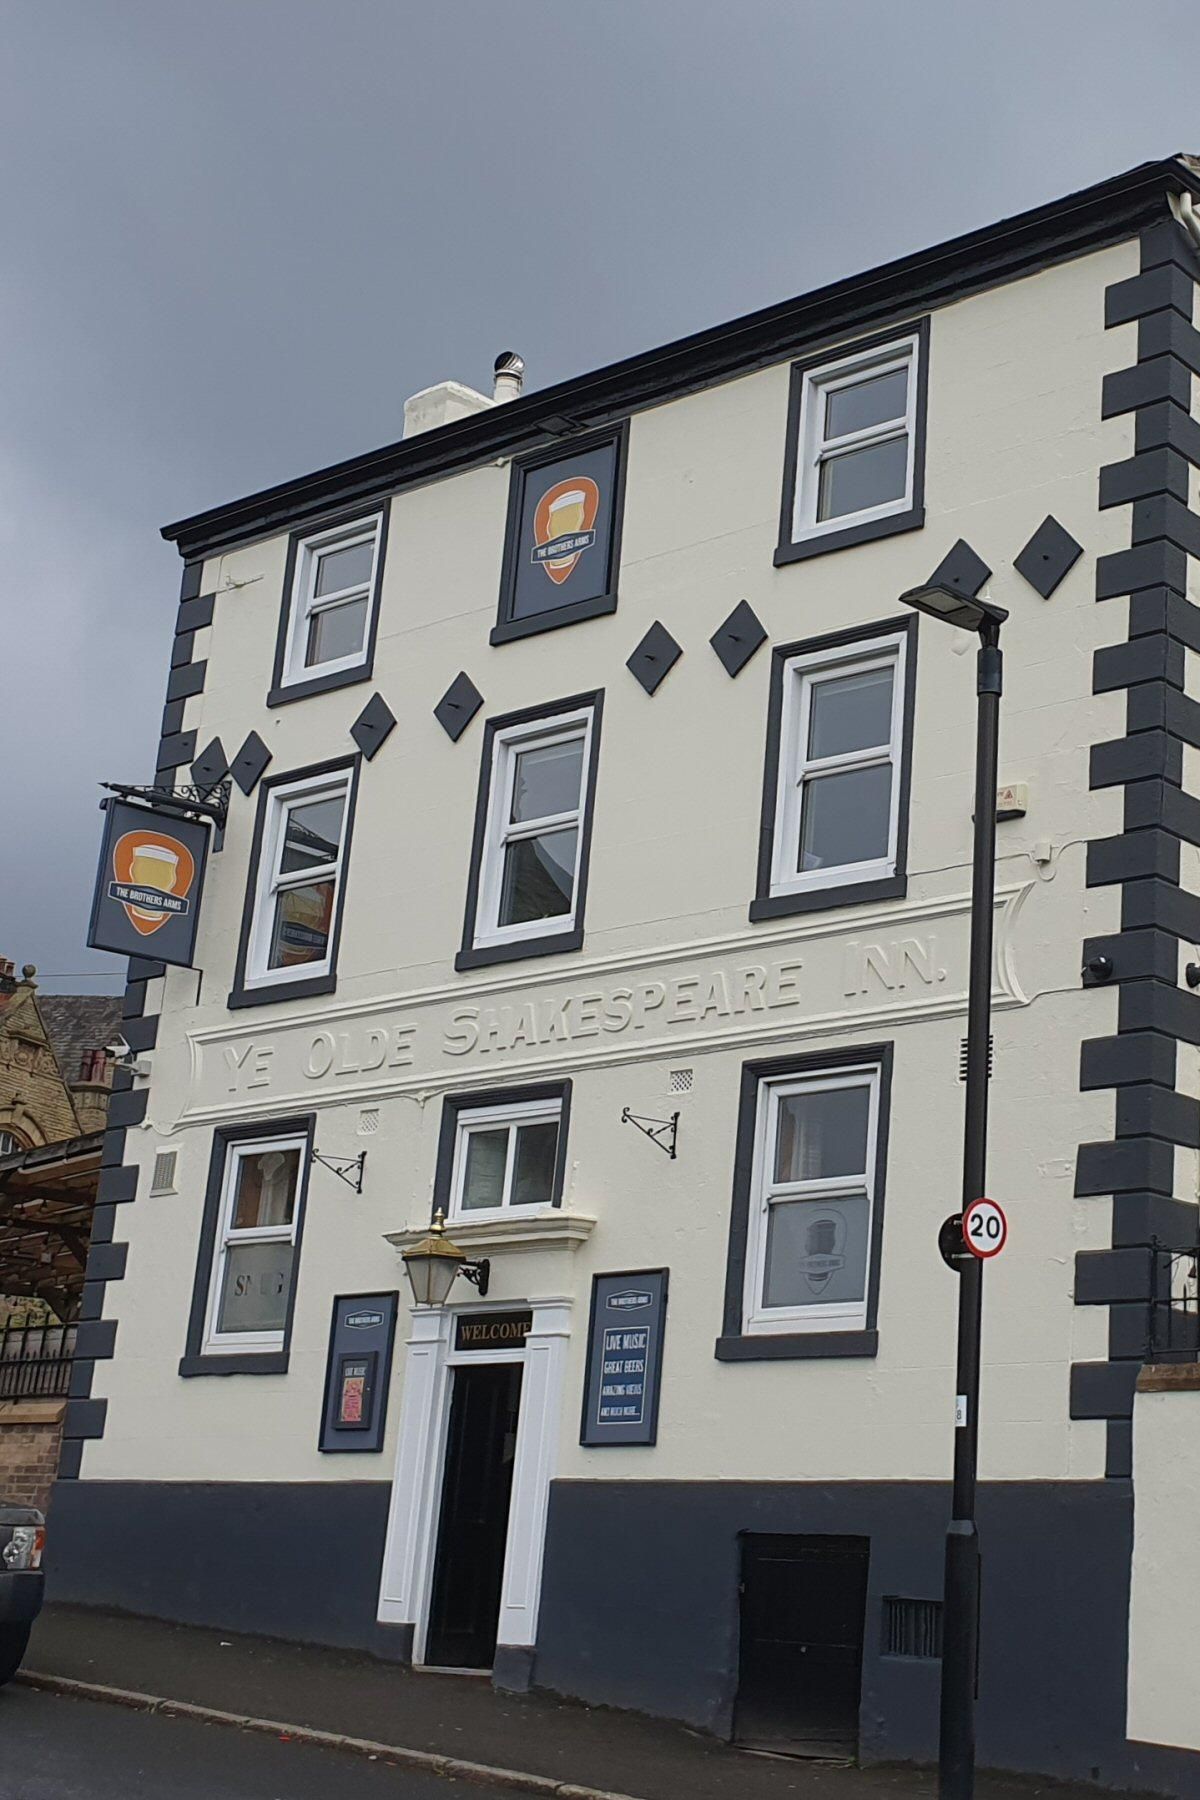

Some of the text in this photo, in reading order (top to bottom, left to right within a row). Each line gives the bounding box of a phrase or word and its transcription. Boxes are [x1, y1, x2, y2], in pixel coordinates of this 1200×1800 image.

[537, 548, 547, 559] THE
[116, 886, 182, 911] THE BROTHERS ARMS
[224, 1043, 275, 1092] YE
[302, 1022, 418, 1079] OLDE
[441, 962, 804, 1056] SHAKESPEARE
[970, 1213, 1001, 1239] 20
[461, 1322, 531, 1340] WELCOME
[606, 1333, 646, 1351] LIVE MUSIC
[604, 1360, 644, 1374] GREAT BEERS
